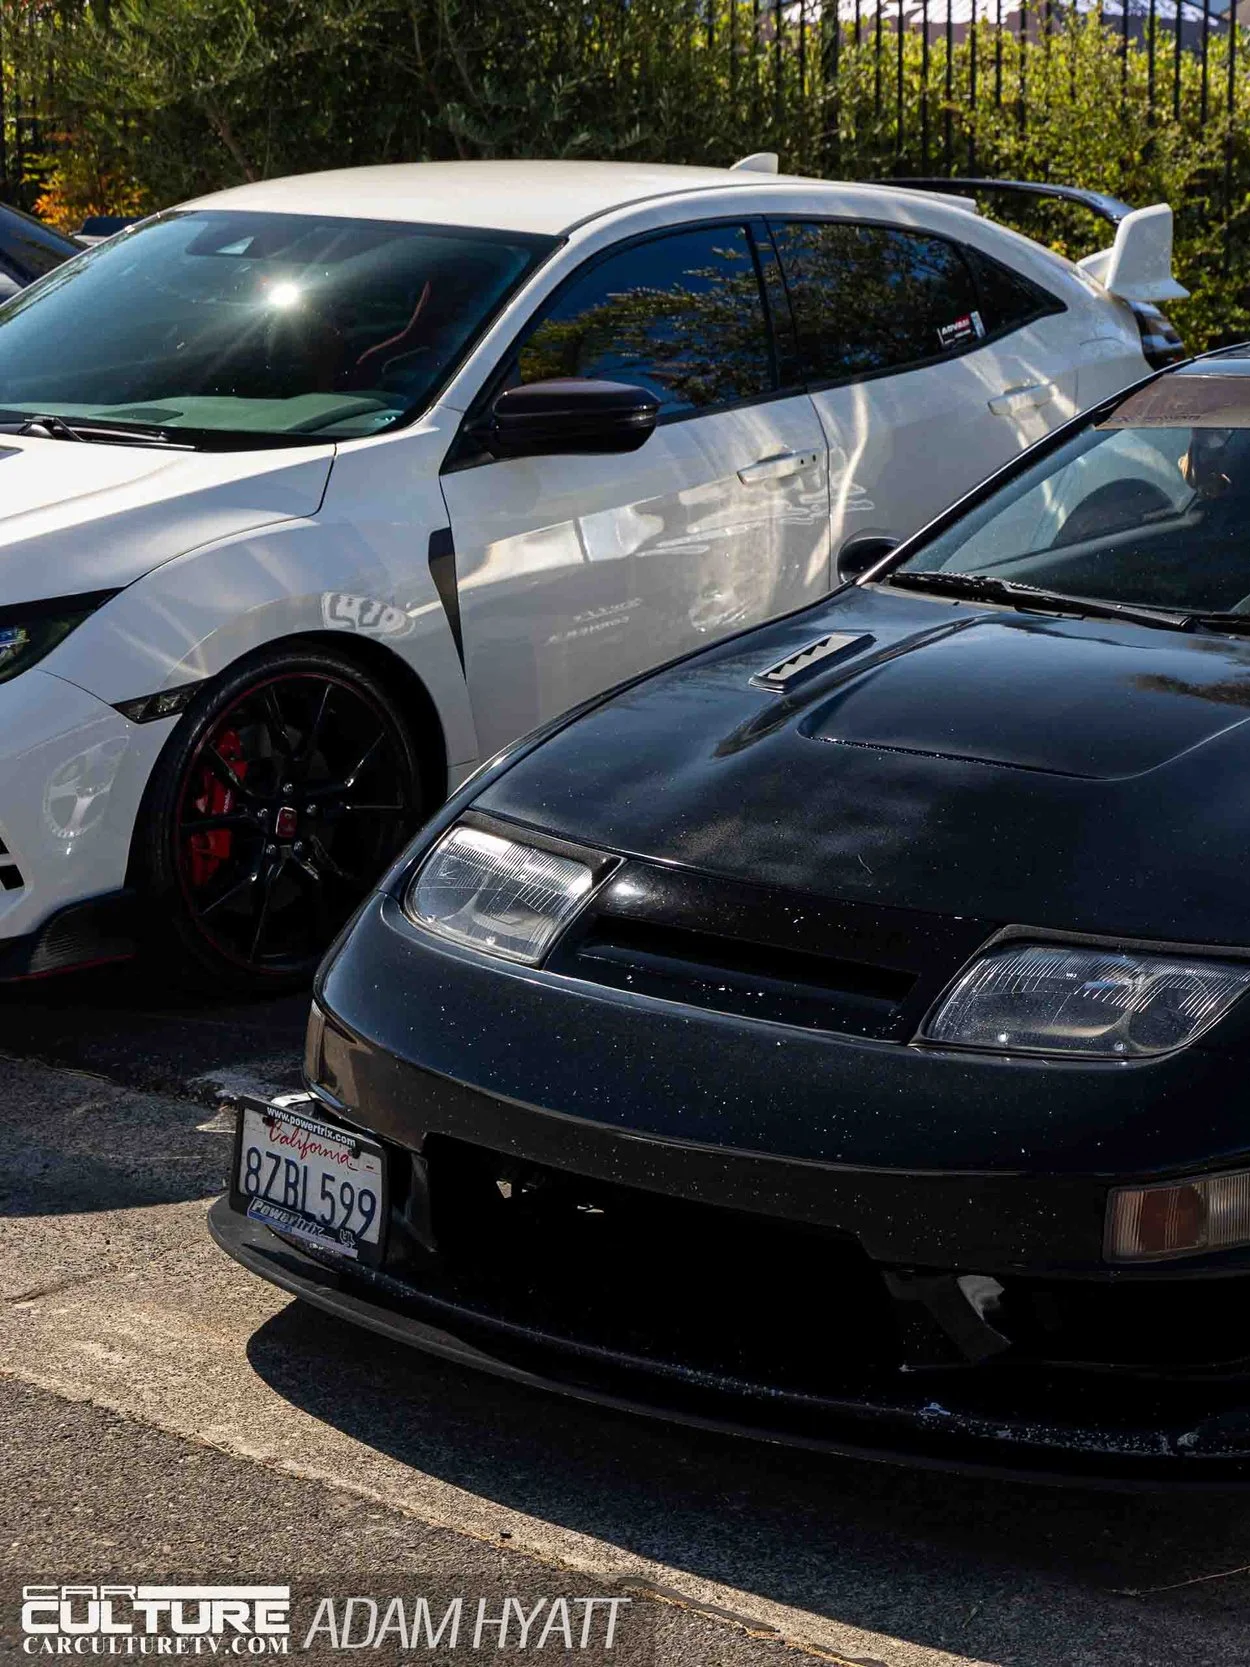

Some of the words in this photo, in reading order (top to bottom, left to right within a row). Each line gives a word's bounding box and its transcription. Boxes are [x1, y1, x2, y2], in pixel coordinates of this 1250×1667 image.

[266, 1106, 356, 1147] www.powertrix.com
[268, 1119, 359, 1172] California
[244, 1147, 377, 1240] 8ZBL599
